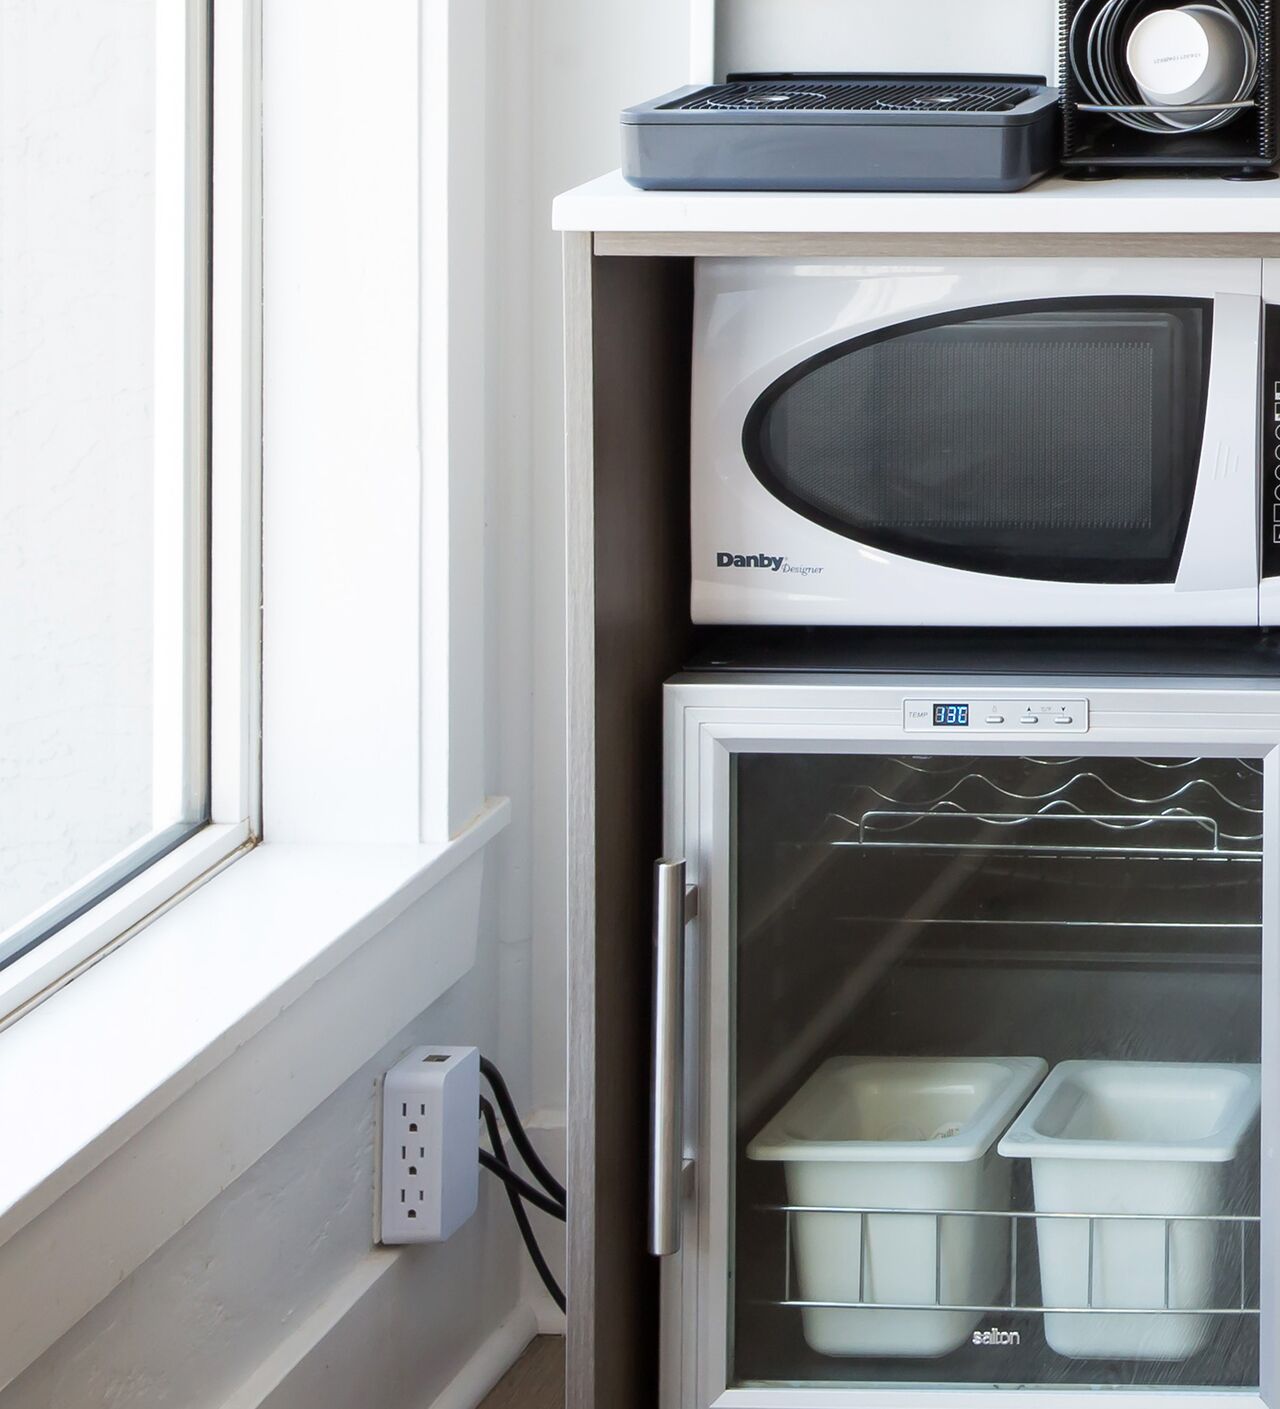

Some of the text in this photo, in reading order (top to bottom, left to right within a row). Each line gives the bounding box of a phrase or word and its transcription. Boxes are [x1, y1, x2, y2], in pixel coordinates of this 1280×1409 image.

[716, 552, 824, 576] Danby Designer
[908, 711, 929, 719] TEMP
[972, 1327, 1020, 1344] salton
